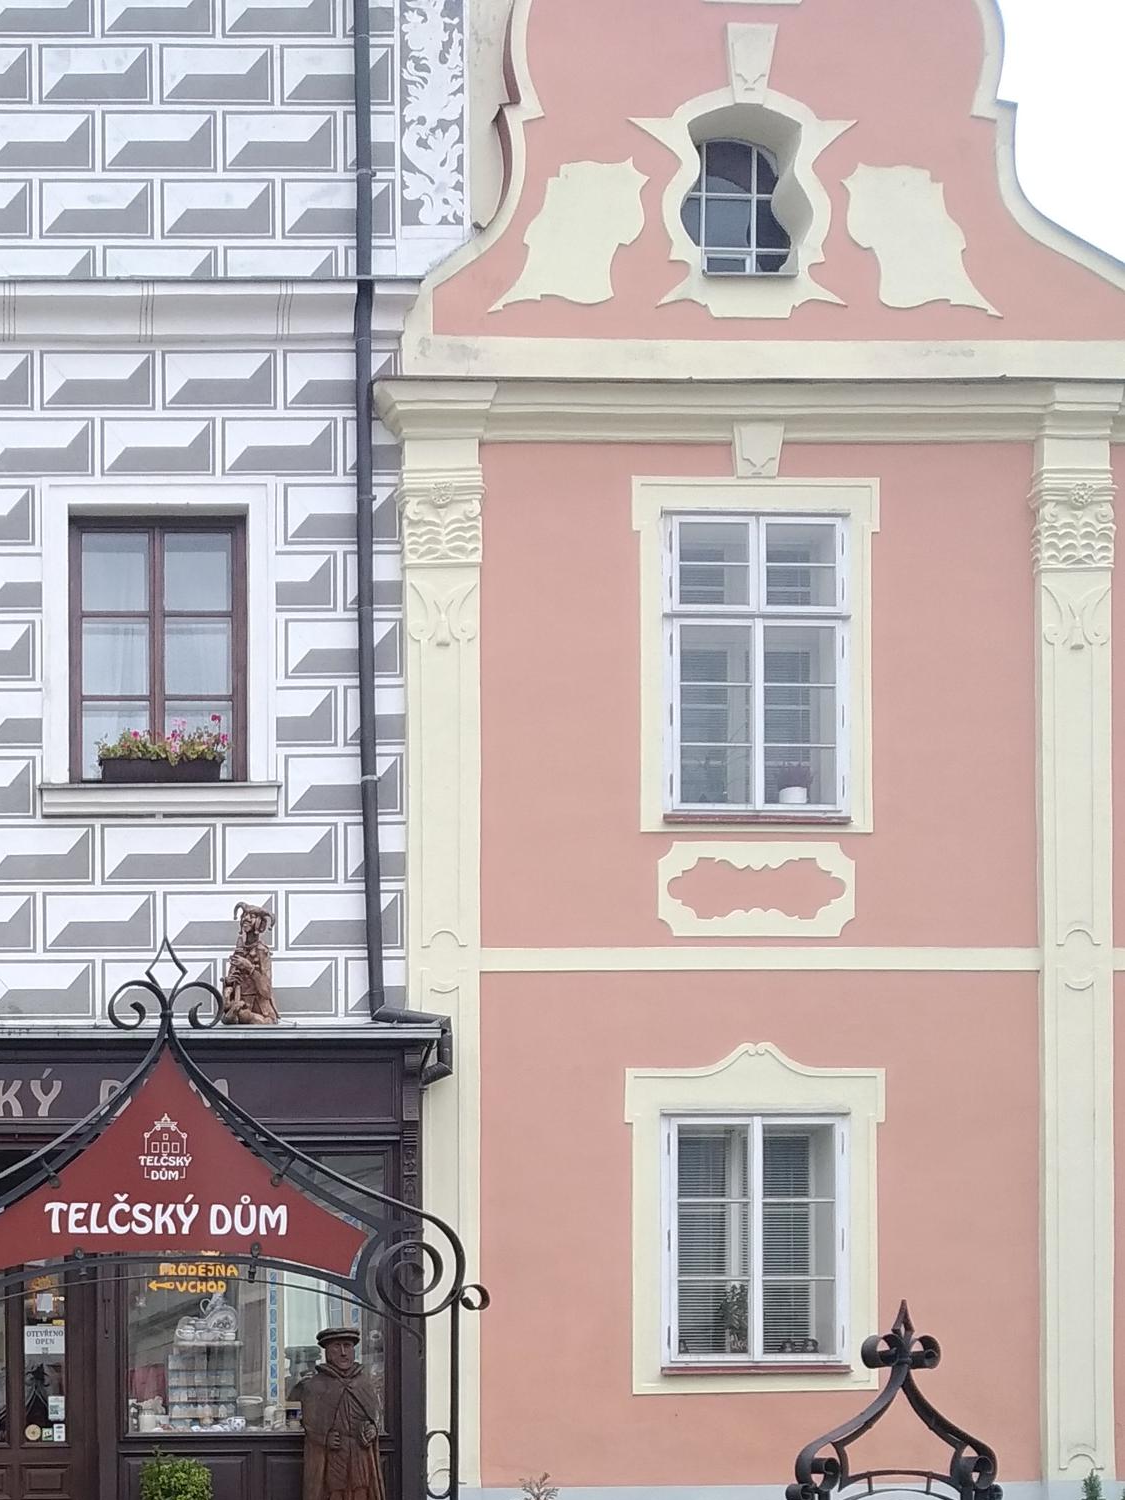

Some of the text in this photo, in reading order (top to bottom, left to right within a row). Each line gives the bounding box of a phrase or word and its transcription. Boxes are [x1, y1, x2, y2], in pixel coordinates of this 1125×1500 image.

[138, 1153, 192, 1167] TELČSKÝ
[151, 1167, 179, 1181] DŮM
[43, 1193, 288, 1236] TELČSKÝ DŮM
[175, 1280, 227, 1293] VCHOD
[26, 1329, 64, 1338] OTEVŘENO
